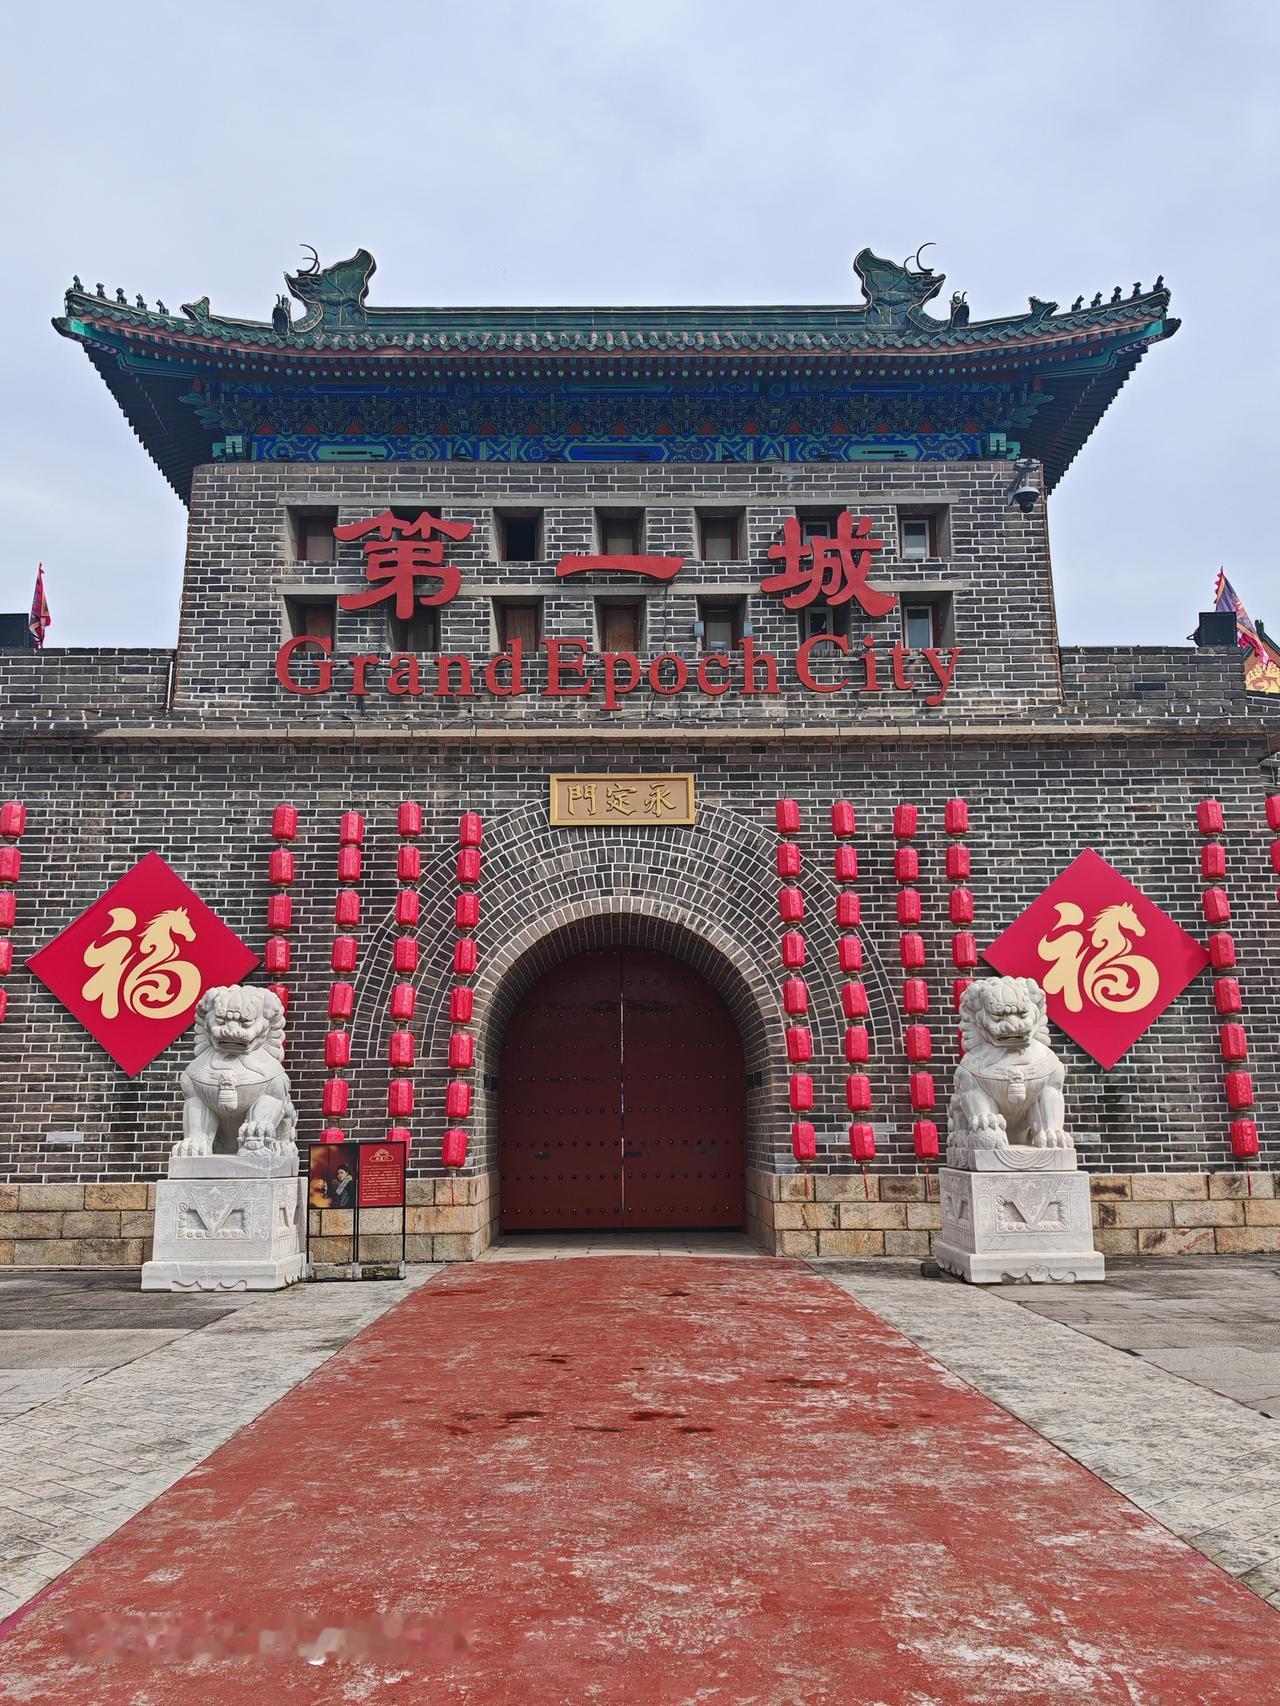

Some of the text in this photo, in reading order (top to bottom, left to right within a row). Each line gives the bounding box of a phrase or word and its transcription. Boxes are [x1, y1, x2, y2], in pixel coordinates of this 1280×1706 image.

[333, 511, 899, 619] 第一城
[275, 634, 961, 711] Grand Epoch City
